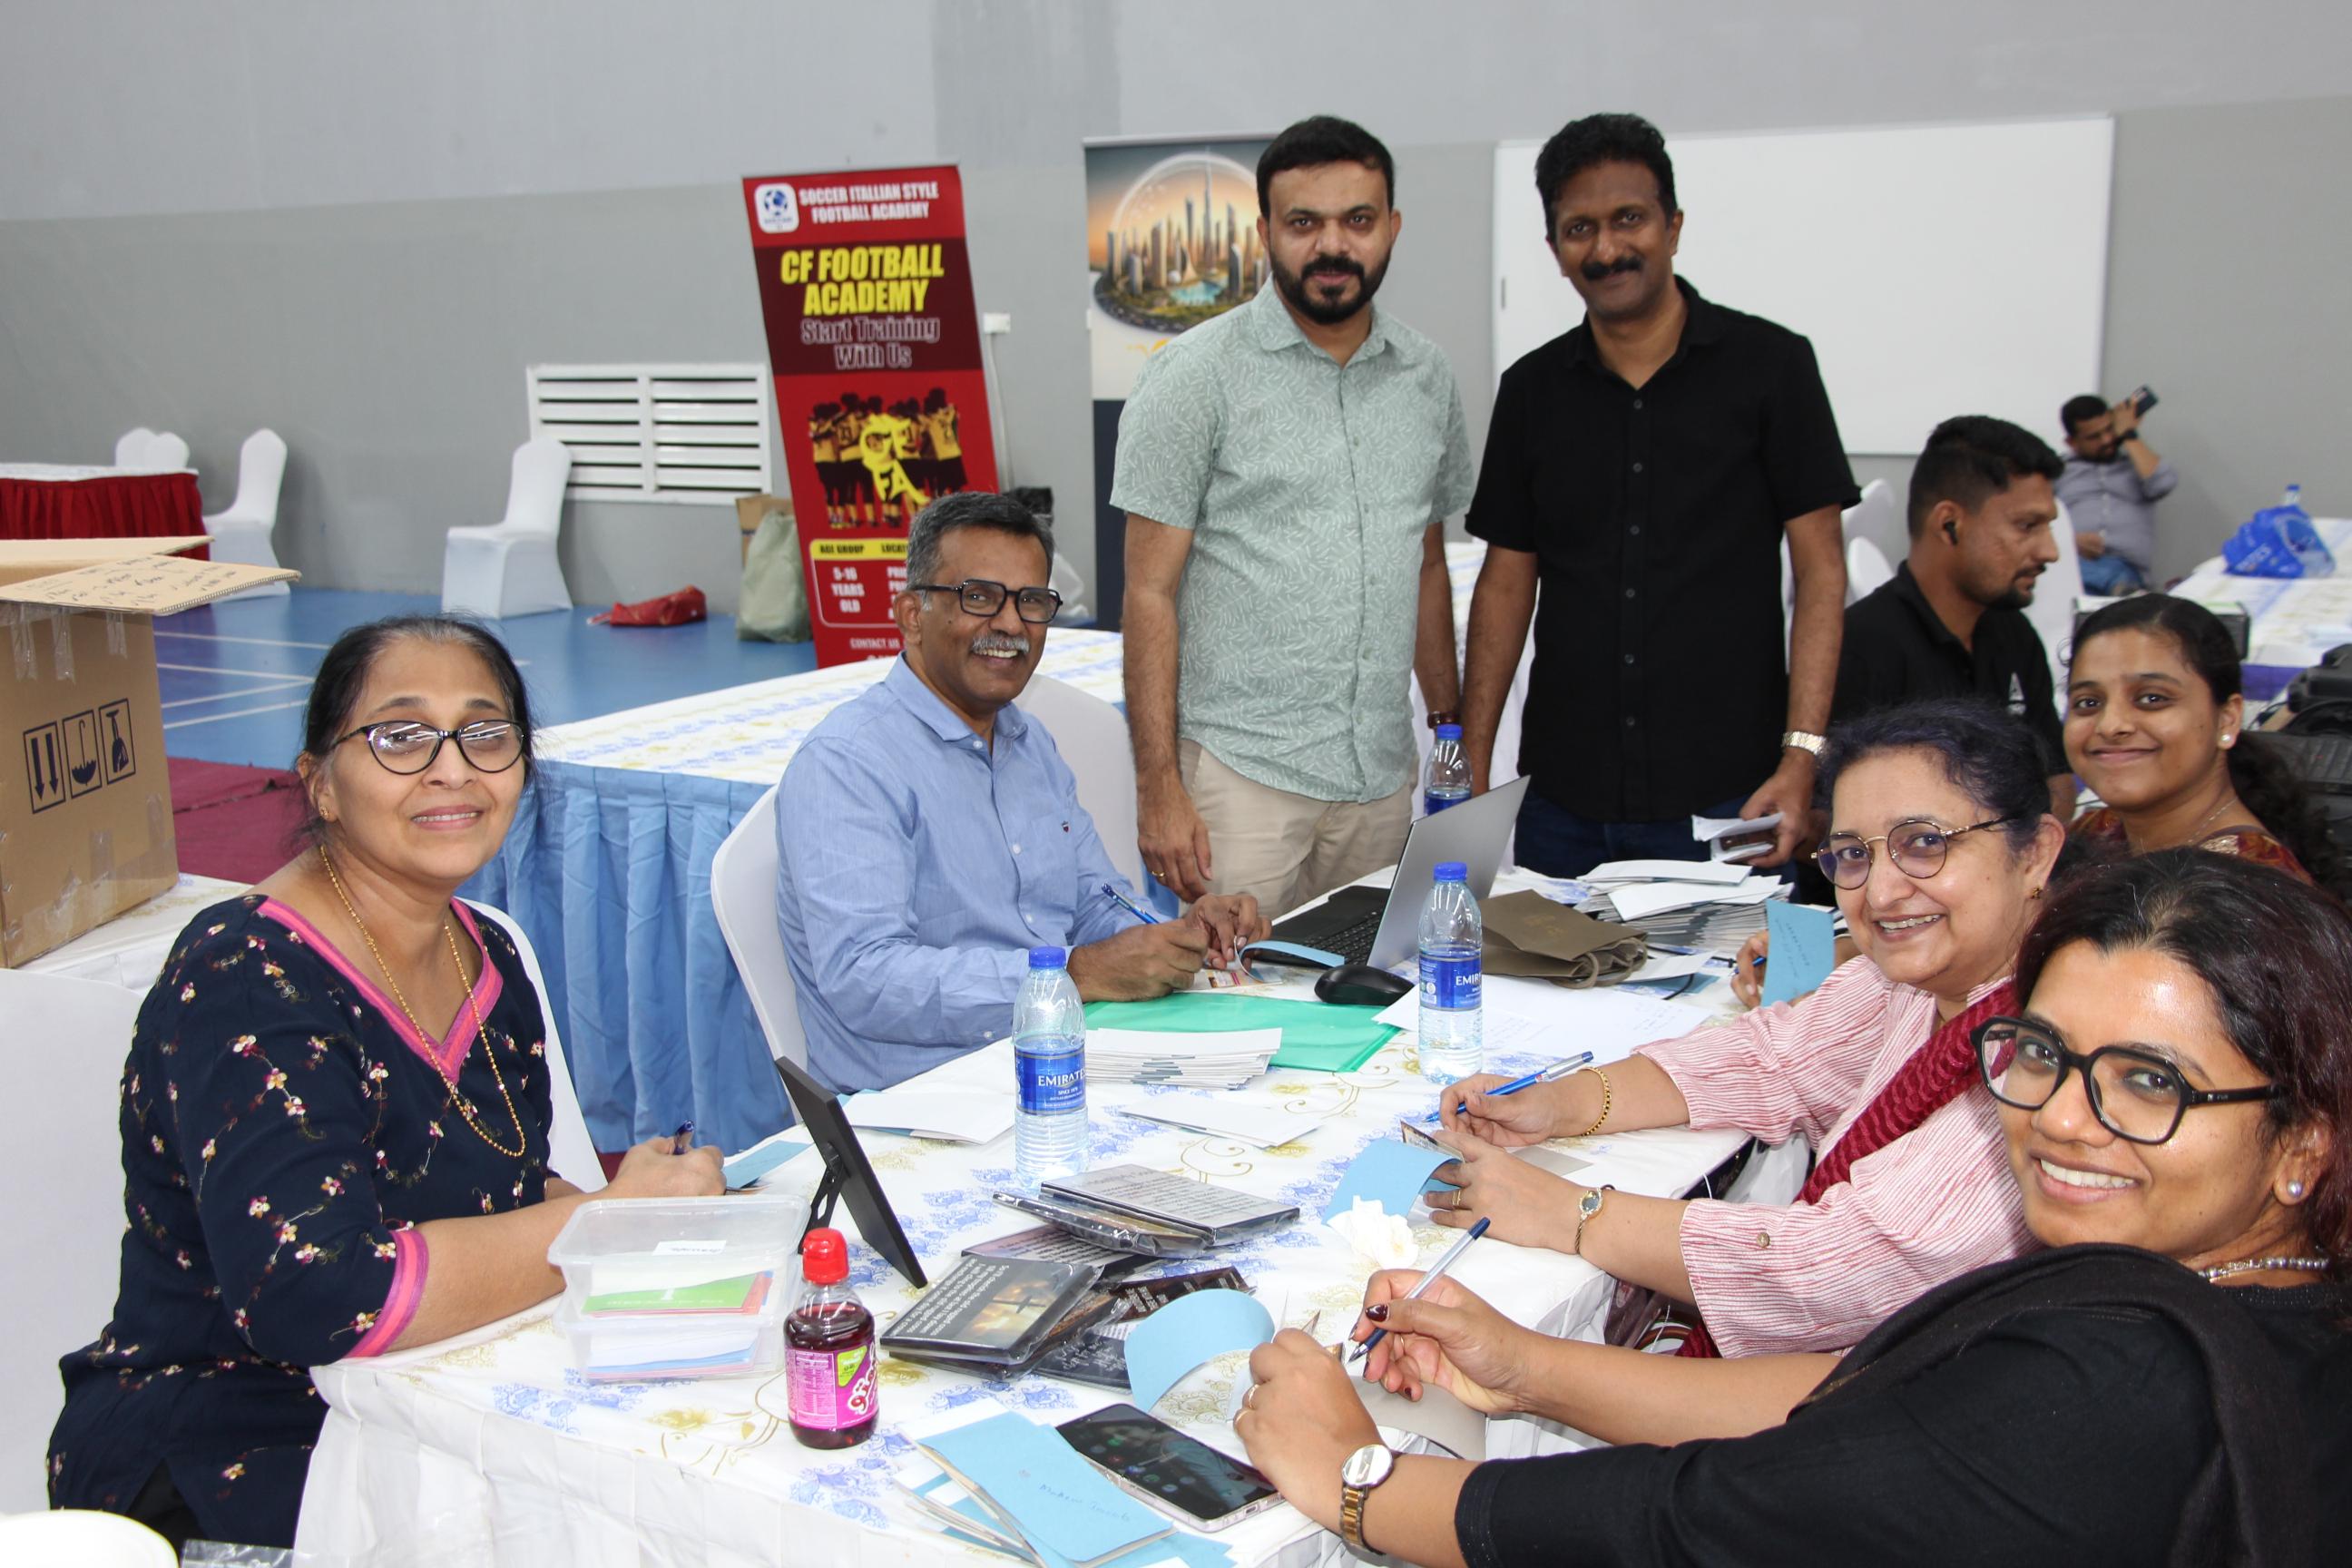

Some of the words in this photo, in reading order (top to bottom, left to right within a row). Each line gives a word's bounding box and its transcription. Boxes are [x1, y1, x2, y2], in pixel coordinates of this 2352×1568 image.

[799, 187, 848, 206] SOCCER
[902, 181, 939, 200] STYLE
[811, 203, 871, 223] FOOTBALL
[872, 201, 929, 220] ACADEMY
[780, 250, 814, 284] CF
[818, 243, 945, 282] FOOTBALL
[803, 279, 929, 316] ACADEMY
[800, 318, 854, 344] Start
[855, 315, 940, 343] Training
[834, 342, 885, 369] With
[887, 344, 913, 368] Us
[830, 582, 865, 596] YEARS
[839, 599, 861, 613] OLD
[849, 637, 887, 650] CONTACT
[1455, 972, 1481, 986] EMIR
